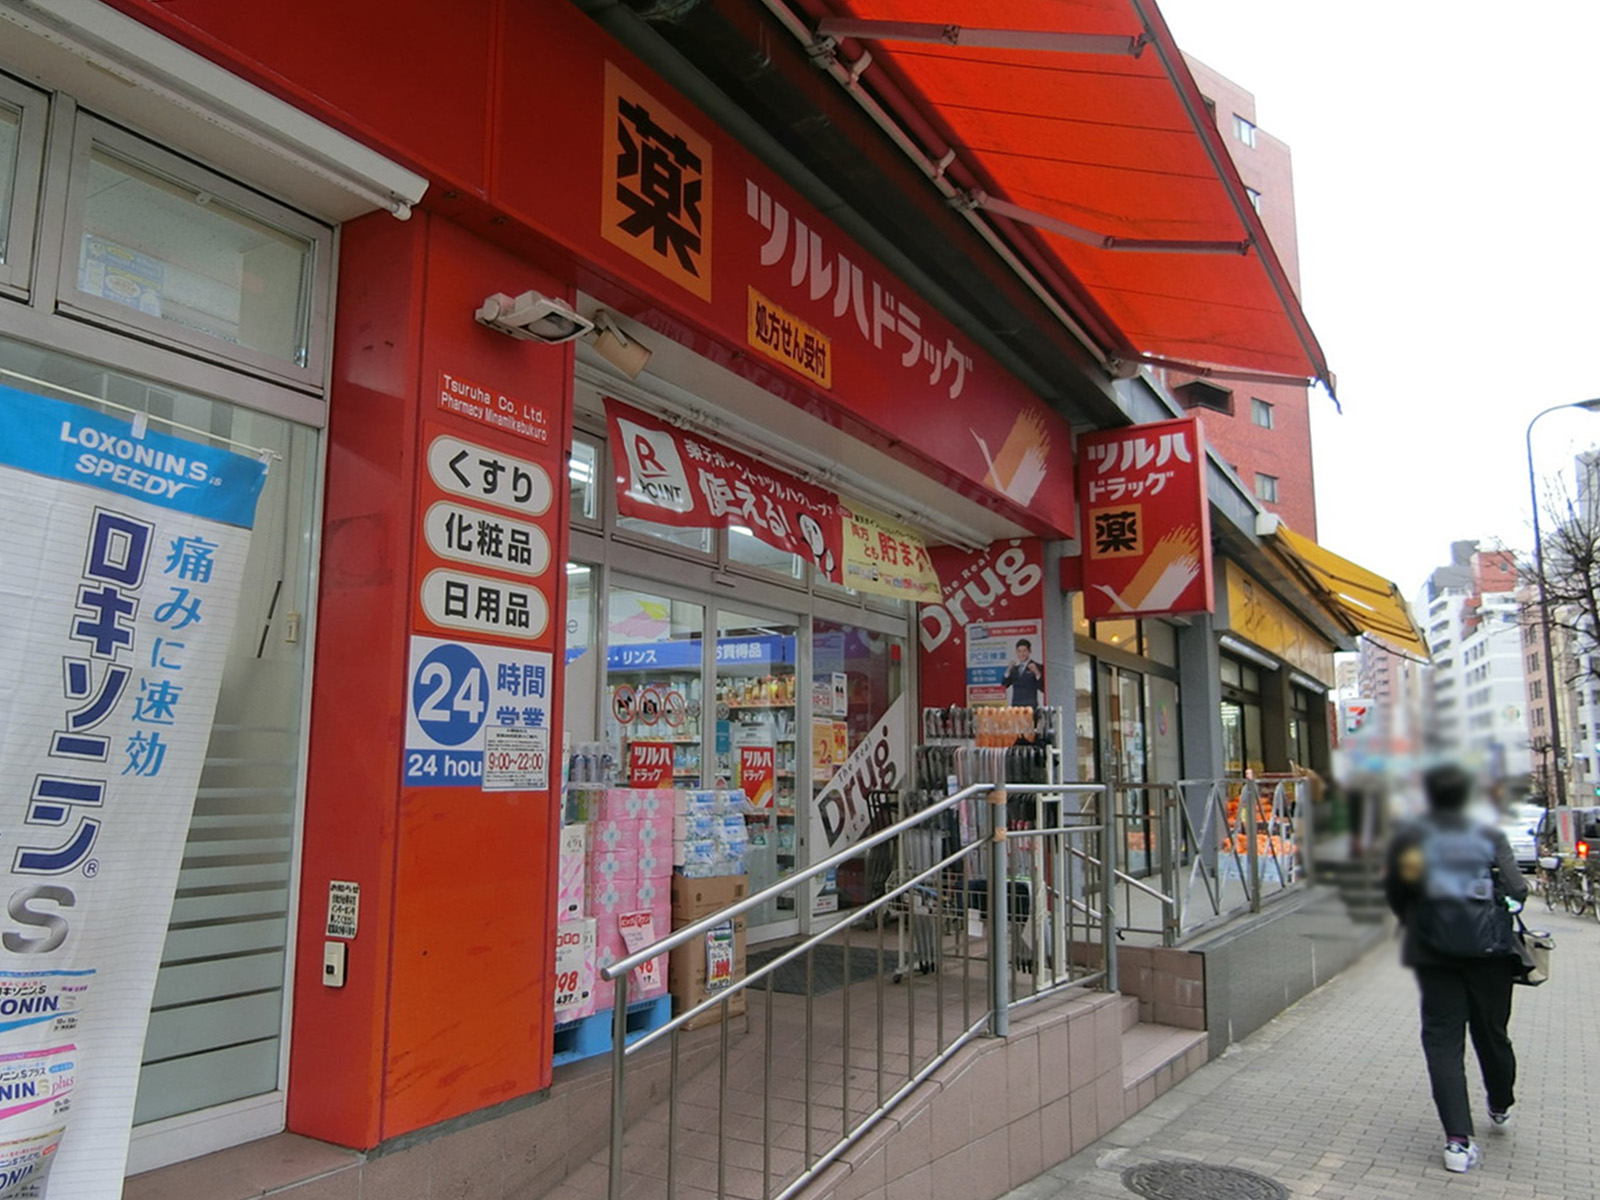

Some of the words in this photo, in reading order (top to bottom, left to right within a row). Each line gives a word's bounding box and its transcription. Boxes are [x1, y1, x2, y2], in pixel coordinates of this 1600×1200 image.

[616, 96, 702, 278] 薬
[745, 177, 974, 400] ツルハドラッグ
[754, 300, 827, 379] 処方せん受付
[441, 391, 483, 420] Pharmacy
[443, 374, 491, 405] Tsuruha
[634, 433, 669, 472] R
[1087, 432, 1191, 474] ツルハ
[74, 453, 200, 499] SPEEDY
[449, 450, 533, 503] くすり
[1089, 471, 1175, 503] ドラッグ
[445, 512, 532, 566] 化粧品
[1094, 510, 1137, 554] 薬
[444, 580, 530, 629] 日用品
[920, 540, 1042, 653] Drug
[121, 535, 219, 777] 痛みに速効
[11, 506, 156, 877] ロキソニン
[418, 661, 485, 724] 24
[497, 662, 546, 699] 時間
[407, 753, 438, 777] 24
[633, 767, 663, 782] ドラッグ
[635, 746, 671, 765] ツルハ
[743, 751, 772, 768] ツルハ
[743, 769, 765, 781] ドラッグ
[1, 884, 76, 955] S
[555, 970, 579, 993] 98
